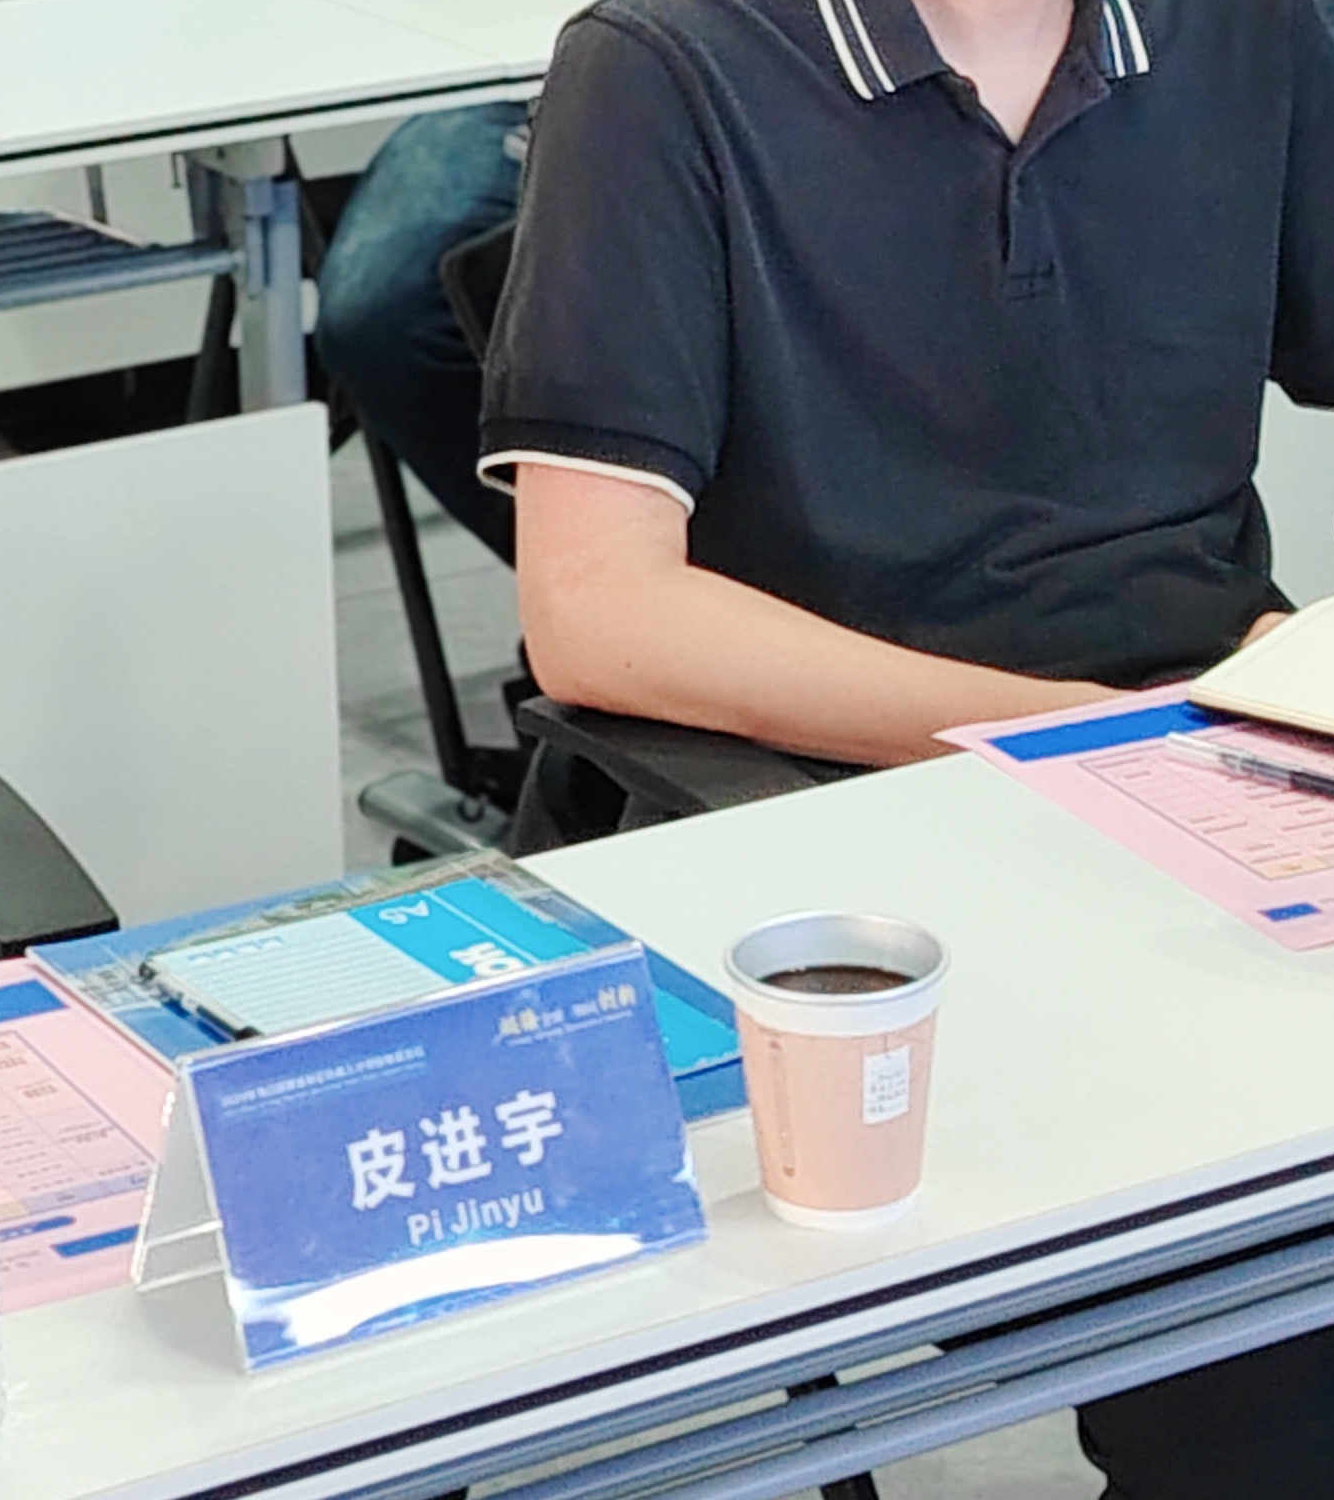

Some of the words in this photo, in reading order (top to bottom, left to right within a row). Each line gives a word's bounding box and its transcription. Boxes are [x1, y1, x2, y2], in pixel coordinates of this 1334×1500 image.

[347, 1091, 564, 1211] 皮进宇
[408, 1214, 442, 1246] Pi
[452, 1187, 543, 1231] Jinyu
